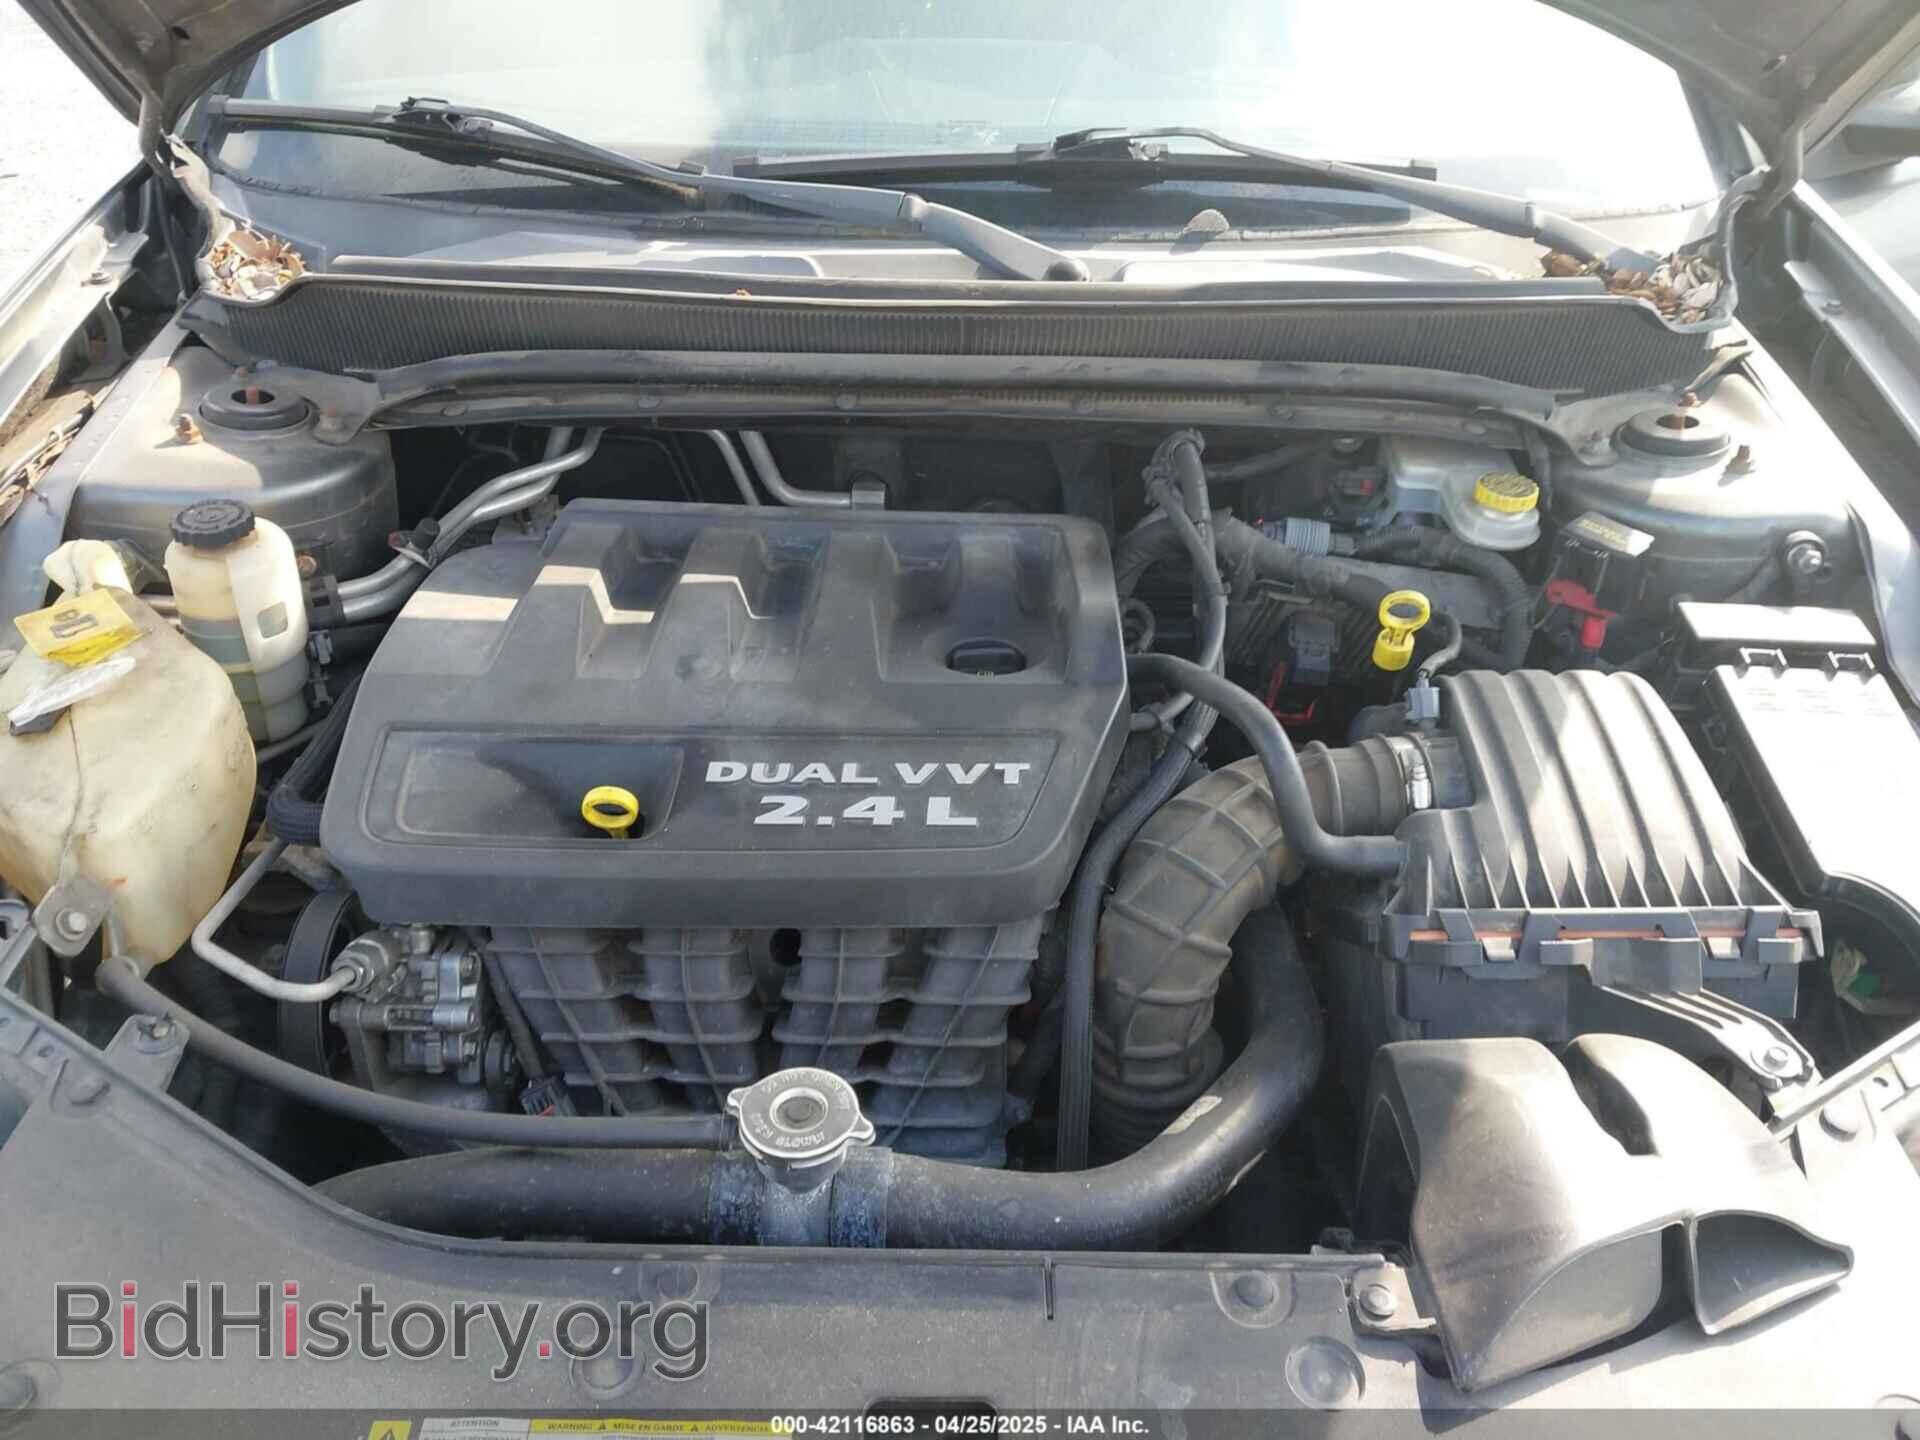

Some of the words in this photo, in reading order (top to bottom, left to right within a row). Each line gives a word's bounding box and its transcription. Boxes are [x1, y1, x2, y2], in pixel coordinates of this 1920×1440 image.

[705, 761, 879, 784] DUAL
[895, 762, 1030, 785] VVT
[753, 795, 904, 826] 2.4
[926, 796, 977, 826] L
